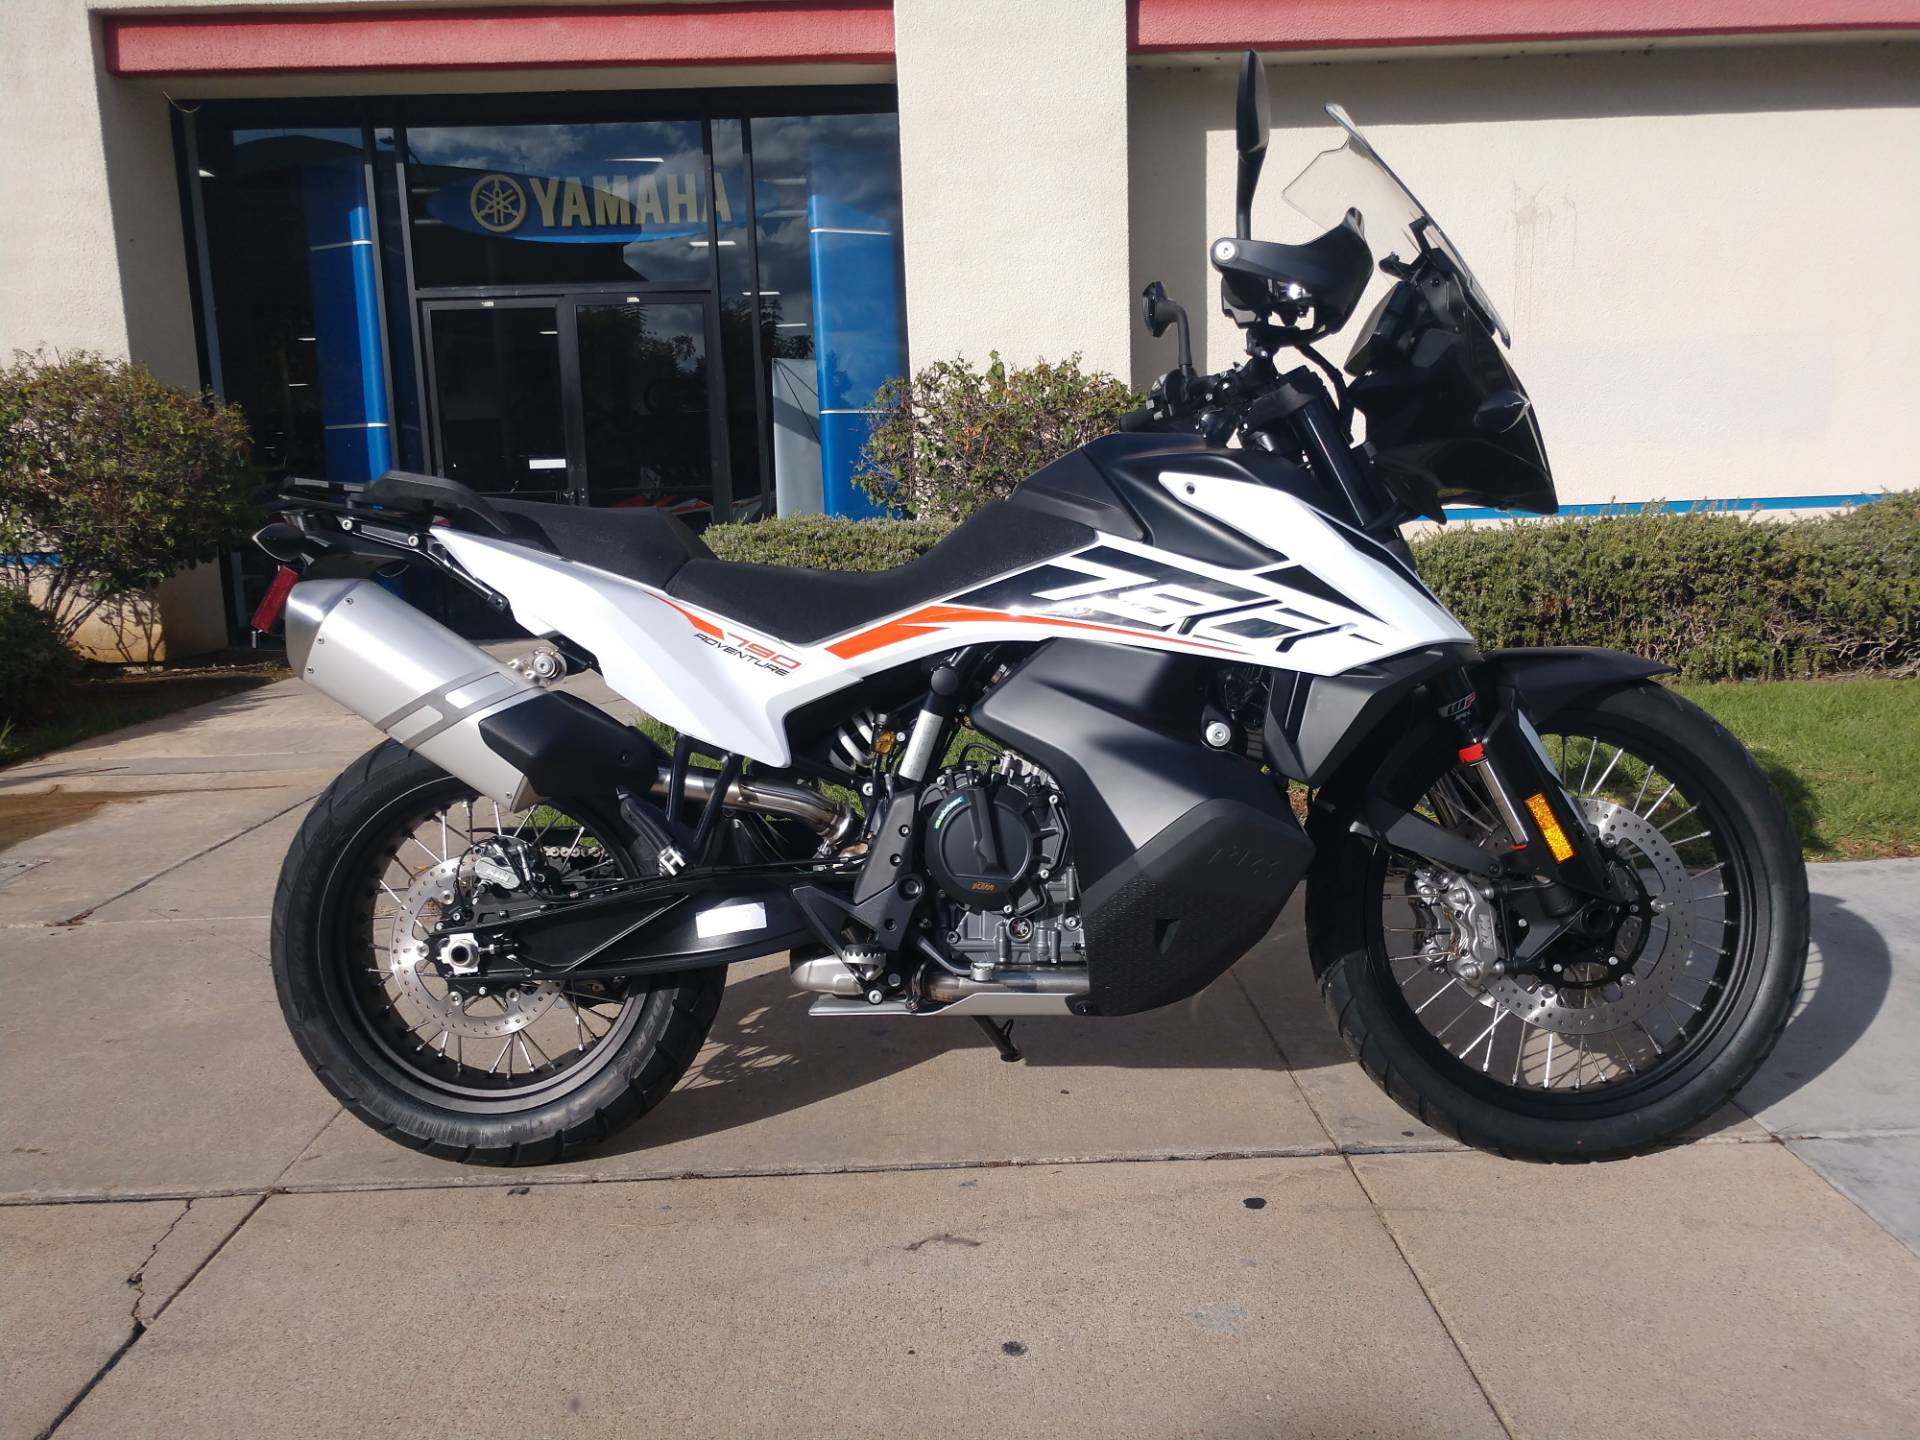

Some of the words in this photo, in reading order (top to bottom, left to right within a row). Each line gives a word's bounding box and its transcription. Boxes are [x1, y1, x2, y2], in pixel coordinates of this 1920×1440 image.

[531, 174, 732, 227] YAMAHA
[694, 633, 790, 676] ADVENTURE
[727, 632, 802, 669] 790
